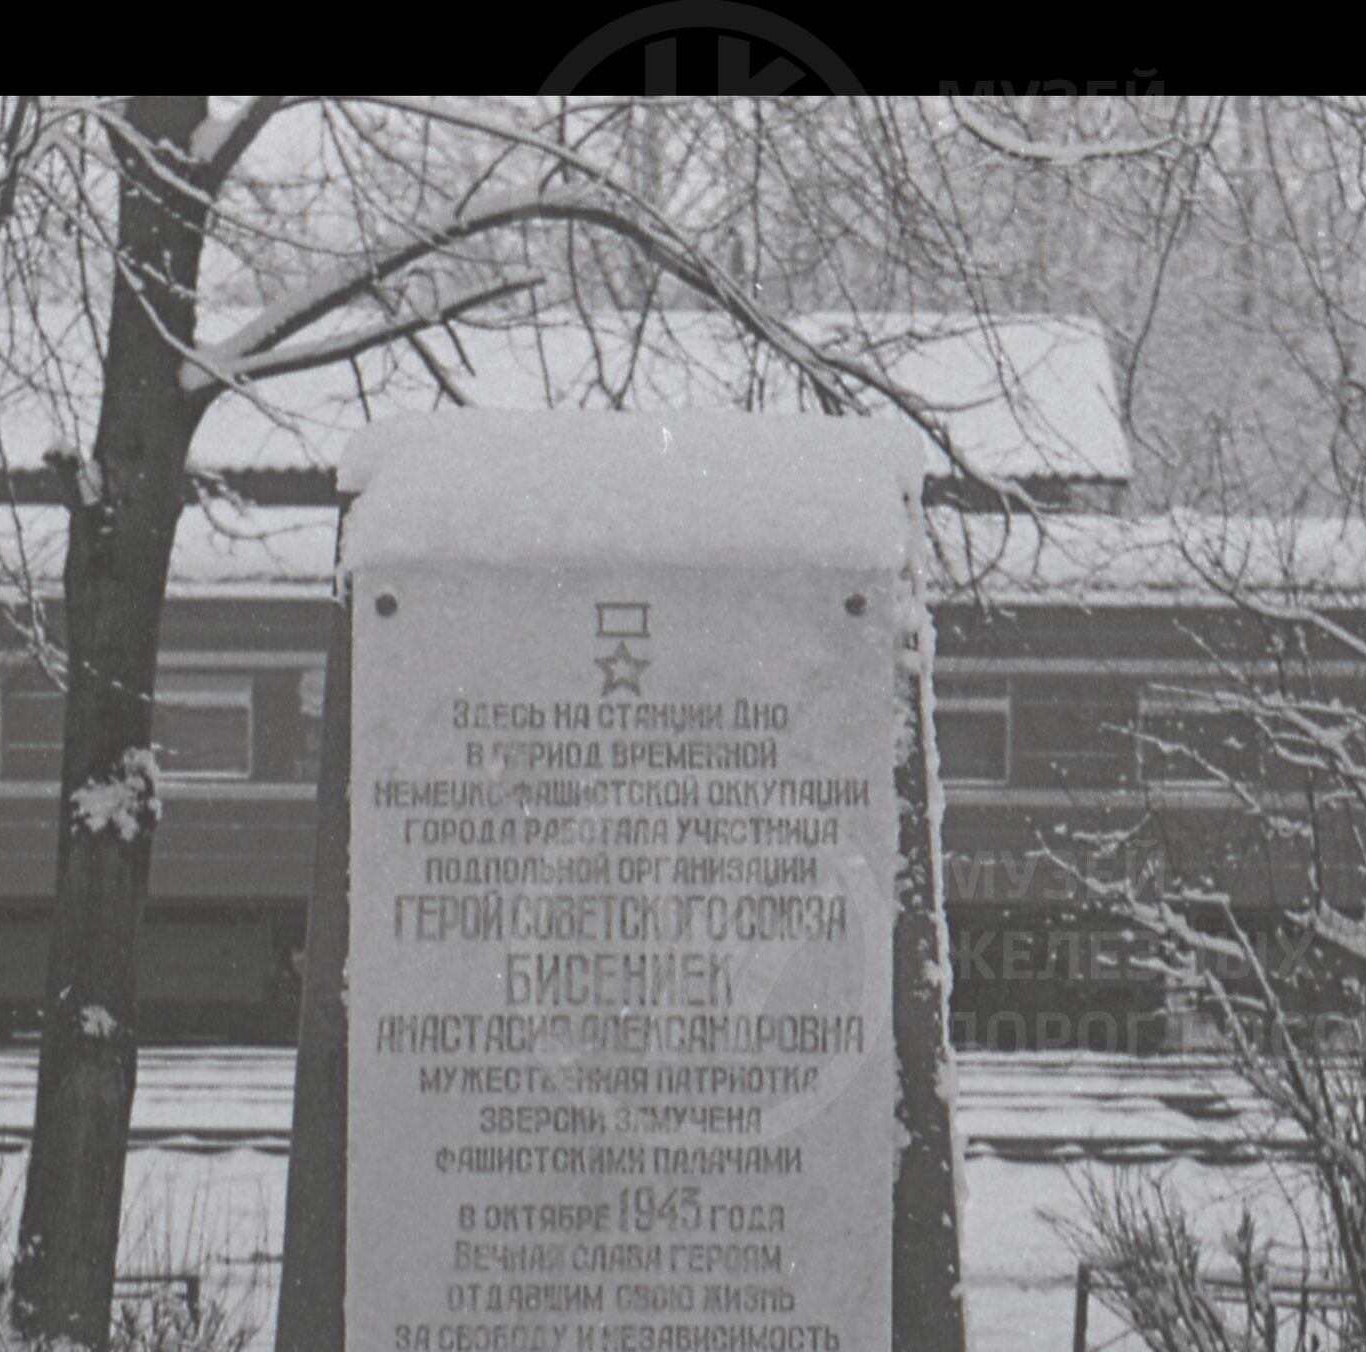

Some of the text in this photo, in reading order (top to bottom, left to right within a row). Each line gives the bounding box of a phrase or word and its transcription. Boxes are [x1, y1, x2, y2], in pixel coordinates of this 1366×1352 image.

[554, 703, 590, 730] НА
[597, 703, 723, 733] СТАНЦИИ
[466, 742, 484, 769] В
[611, 737, 778, 770] ВРЕМЕННОЙ
[707, 779, 871, 812] ОККУПАЦИИ
[404, 817, 839, 848] ГОРОДА РАБОТАЛА УЧАСТНИЦА
[425, 852, 818, 888] ПОДПОЛЬНОЙ ОРГАНИЗАЦИИ
[394, 889, 848, 942] ГЕРОЙ СОВЕТСКОГО СОЮЗА
[506, 953, 734, 1008] БИСЕНИЕК
[376, 1014, 865, 1055] АНАСТАСИЯ АЛЕКСАНДРОВНА
[657, 1066, 820, 1094] ПАТРИОТКА
[479, 1105, 607, 1135] ЗВЕРСКИ
[435, 1146, 804, 1176] ФАШИСТСКИМИ ПАЛАЧАМИ
[458, 1186, 786, 1233] В ОКТЯБРЕ 1943 ГОДА
[571, 1243, 662, 1272] СЛАВА
[670, 1243, 783, 1273] ГЕРОЯМ
[447, 1284, 797, 1313] ОТДАВШИМ СВОЮ ЖИЗНЬ
[394, 1324, 432, 1352] ЗА
[576, 1324, 595, 1352] И
